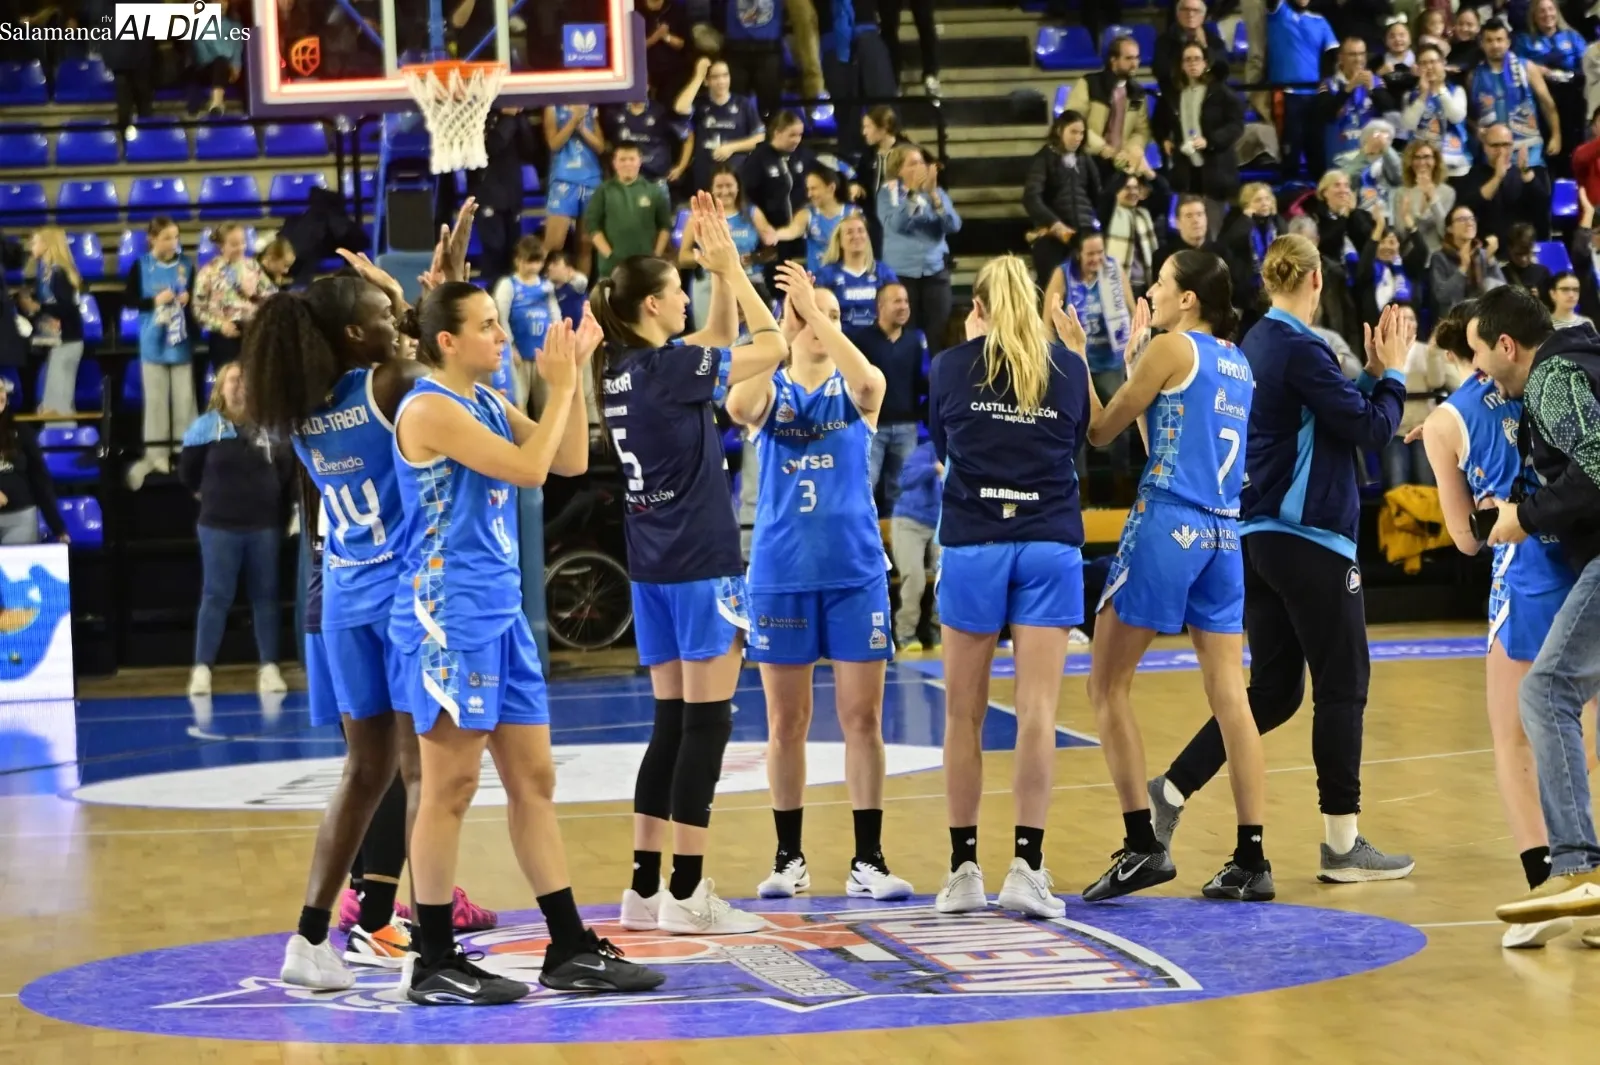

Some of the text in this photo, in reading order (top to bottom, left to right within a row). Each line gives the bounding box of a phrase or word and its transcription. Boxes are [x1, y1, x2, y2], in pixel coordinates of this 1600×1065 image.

[611, 427, 645, 491] 5
[1218, 427, 1241, 494] 7
[798, 479, 817, 513] 3
[979, 487, 1040, 500] SALAMANCA
